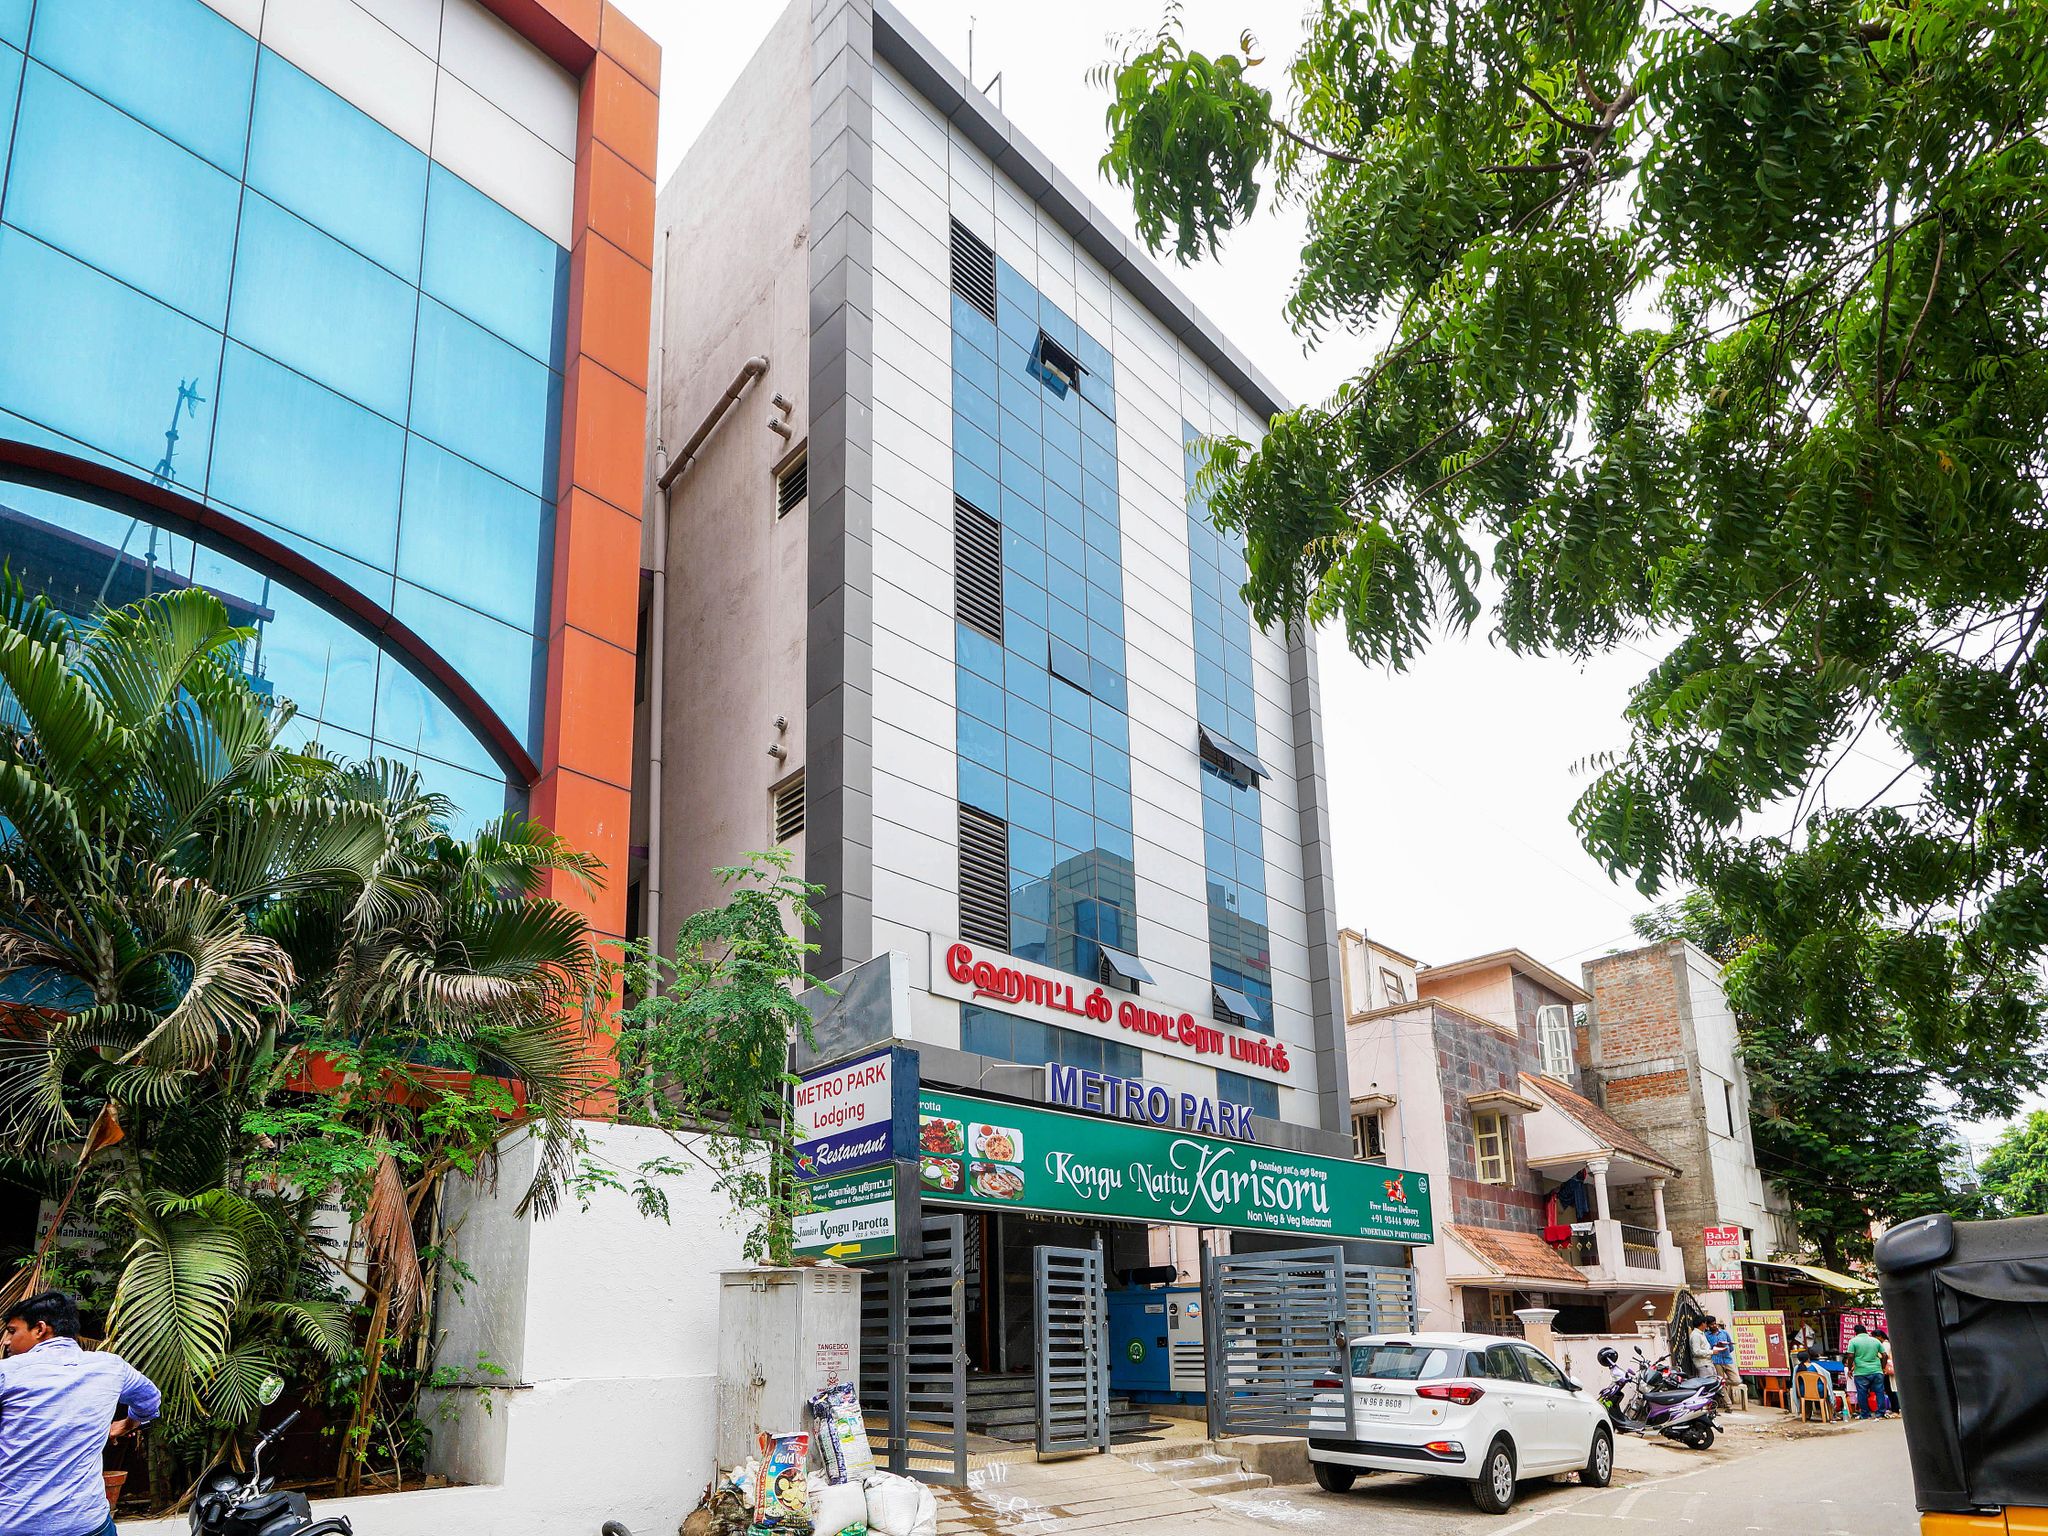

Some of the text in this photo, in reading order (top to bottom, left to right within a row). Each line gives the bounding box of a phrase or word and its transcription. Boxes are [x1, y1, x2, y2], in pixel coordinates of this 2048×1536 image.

[946, 943, 1291, 1073] ஹோட்டல் மெட்ரோ பார்க்
[796, 1062, 887, 1108] METRO PARK
[919, 1101, 942, 1112] rotta
[1048, 1062, 1256, 1140] METRO PARK
[814, 1101, 865, 1129] Lodging
[815, 1132, 887, 1167] Restaurant
[1045, 1138, 1331, 1216] Kongu Nattu Karisoru
[1369, 1200, 1419, 1217] Free Home Delivery
[1247, 1209, 1263, 1222] Non
[1263, 1211, 1279, 1226] Veg
[1280, 1213, 1286, 1224] &
[1286, 1214, 1301, 1228] Veg
[1371, 1214, 1383, 1224] +91
[798, 1217, 889, 1240] Junior Kongu Parotta
[1360, 1226, 1394, 1237] UNDERTAKEN
[1394, 1230, 1411, 1240] PARTY
[1706, 1230, 1738, 1240] Baby
[1359, 1397, 1368, 1406] TN
[775, 1453, 795, 1464] Gold
